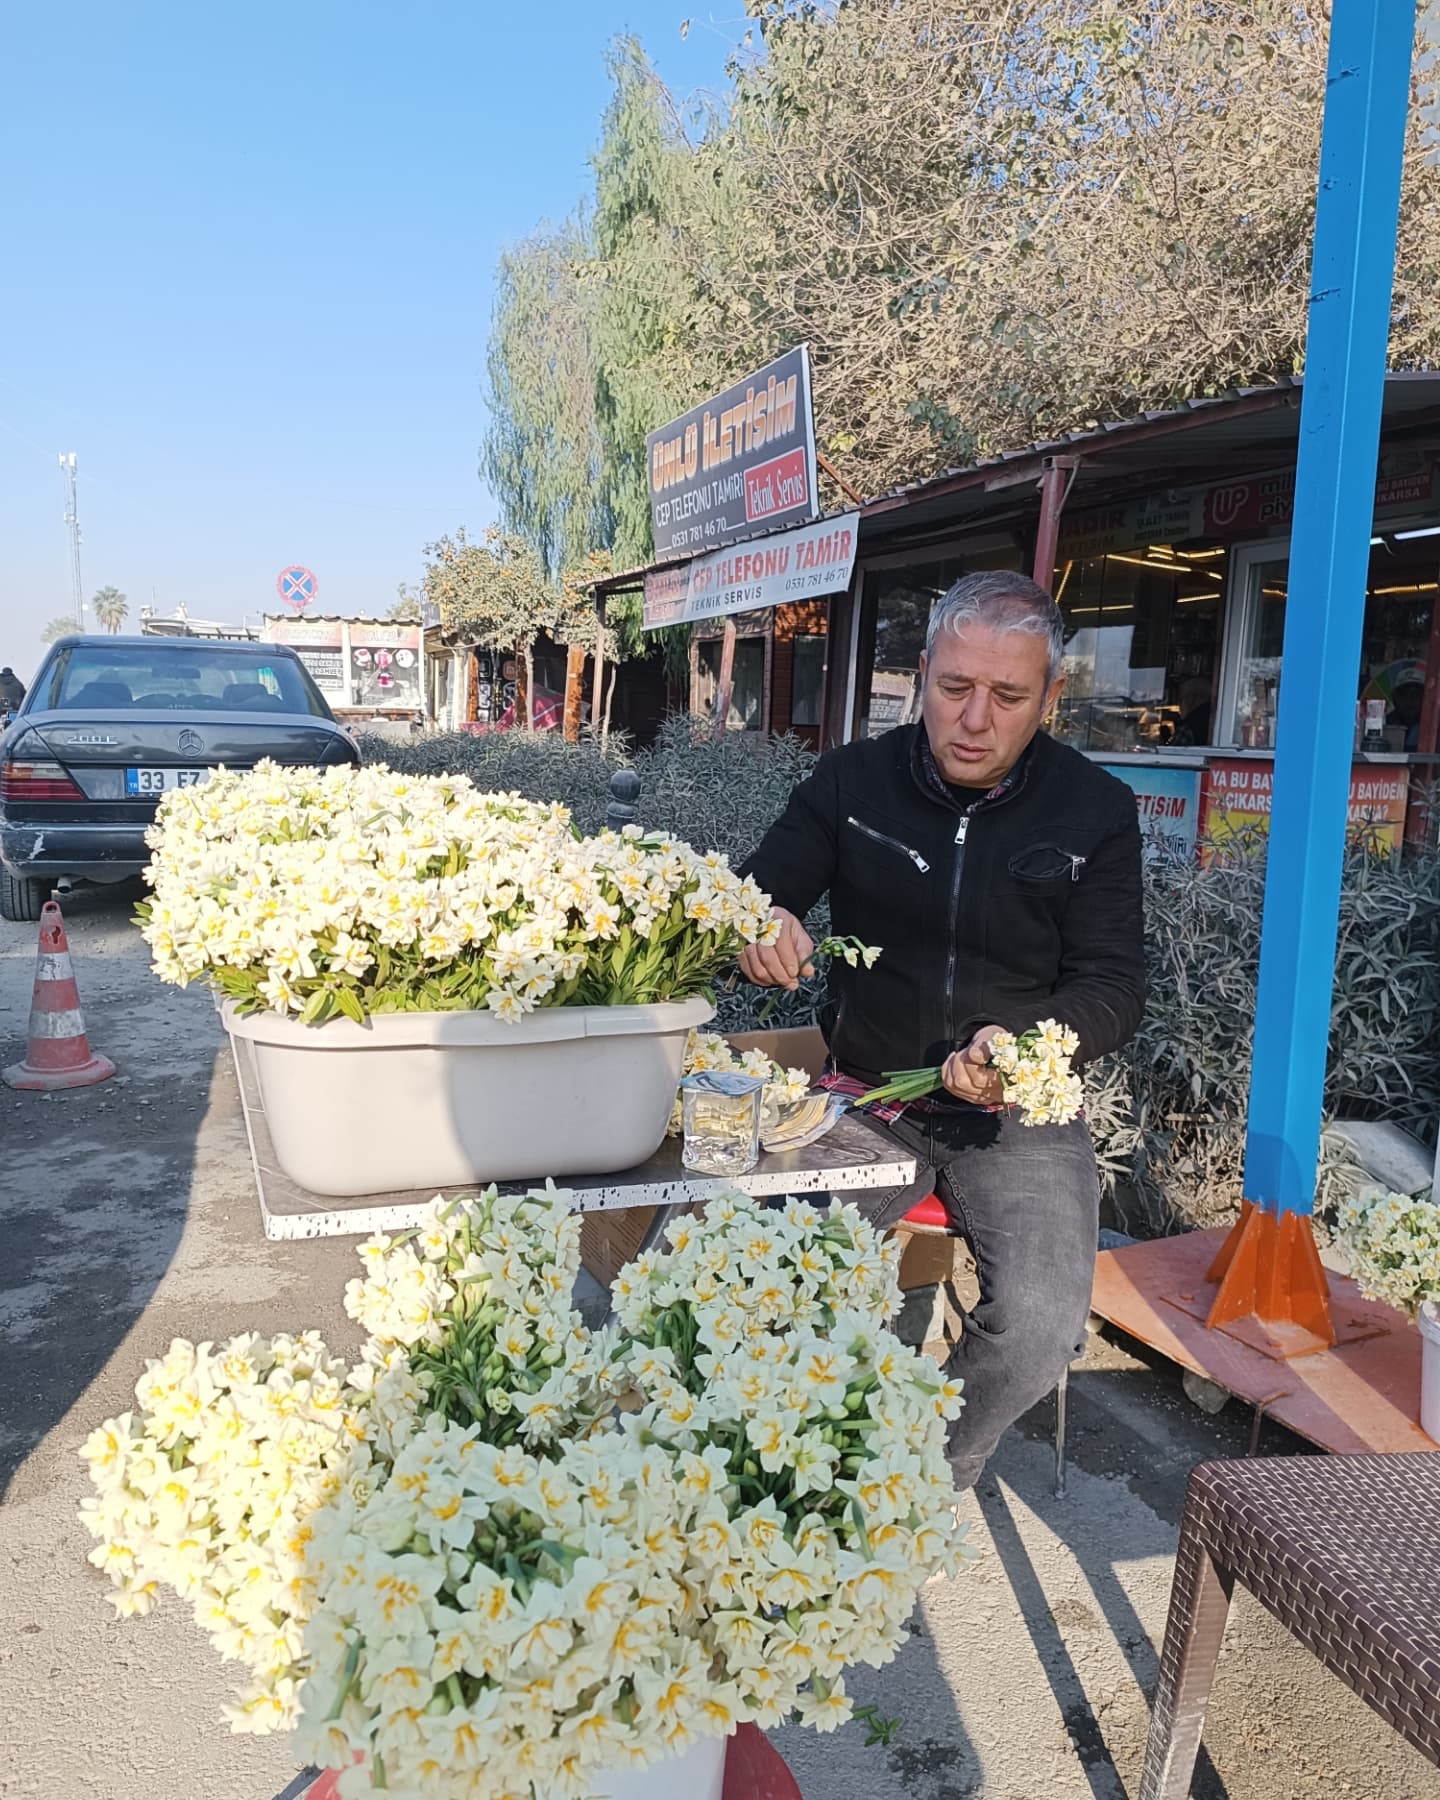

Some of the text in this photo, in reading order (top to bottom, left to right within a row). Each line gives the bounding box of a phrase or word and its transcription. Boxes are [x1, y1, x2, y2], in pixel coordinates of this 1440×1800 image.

[655, 502, 670, 528] CEP
[670, 484, 711, 522] TELEFONU
[748, 465, 803, 516] Teknik Servis
[671, 516, 727, 548] 0531 781 46 70
[693, 566, 712, 593] CEP
[716, 545, 790, 588] TELEFONU
[785, 567, 849, 591] 0531 781 46 70
[140, 771, 164, 790] 33
[1211, 769, 1227, 787] YA
[1230, 771, 1249, 788] BU
